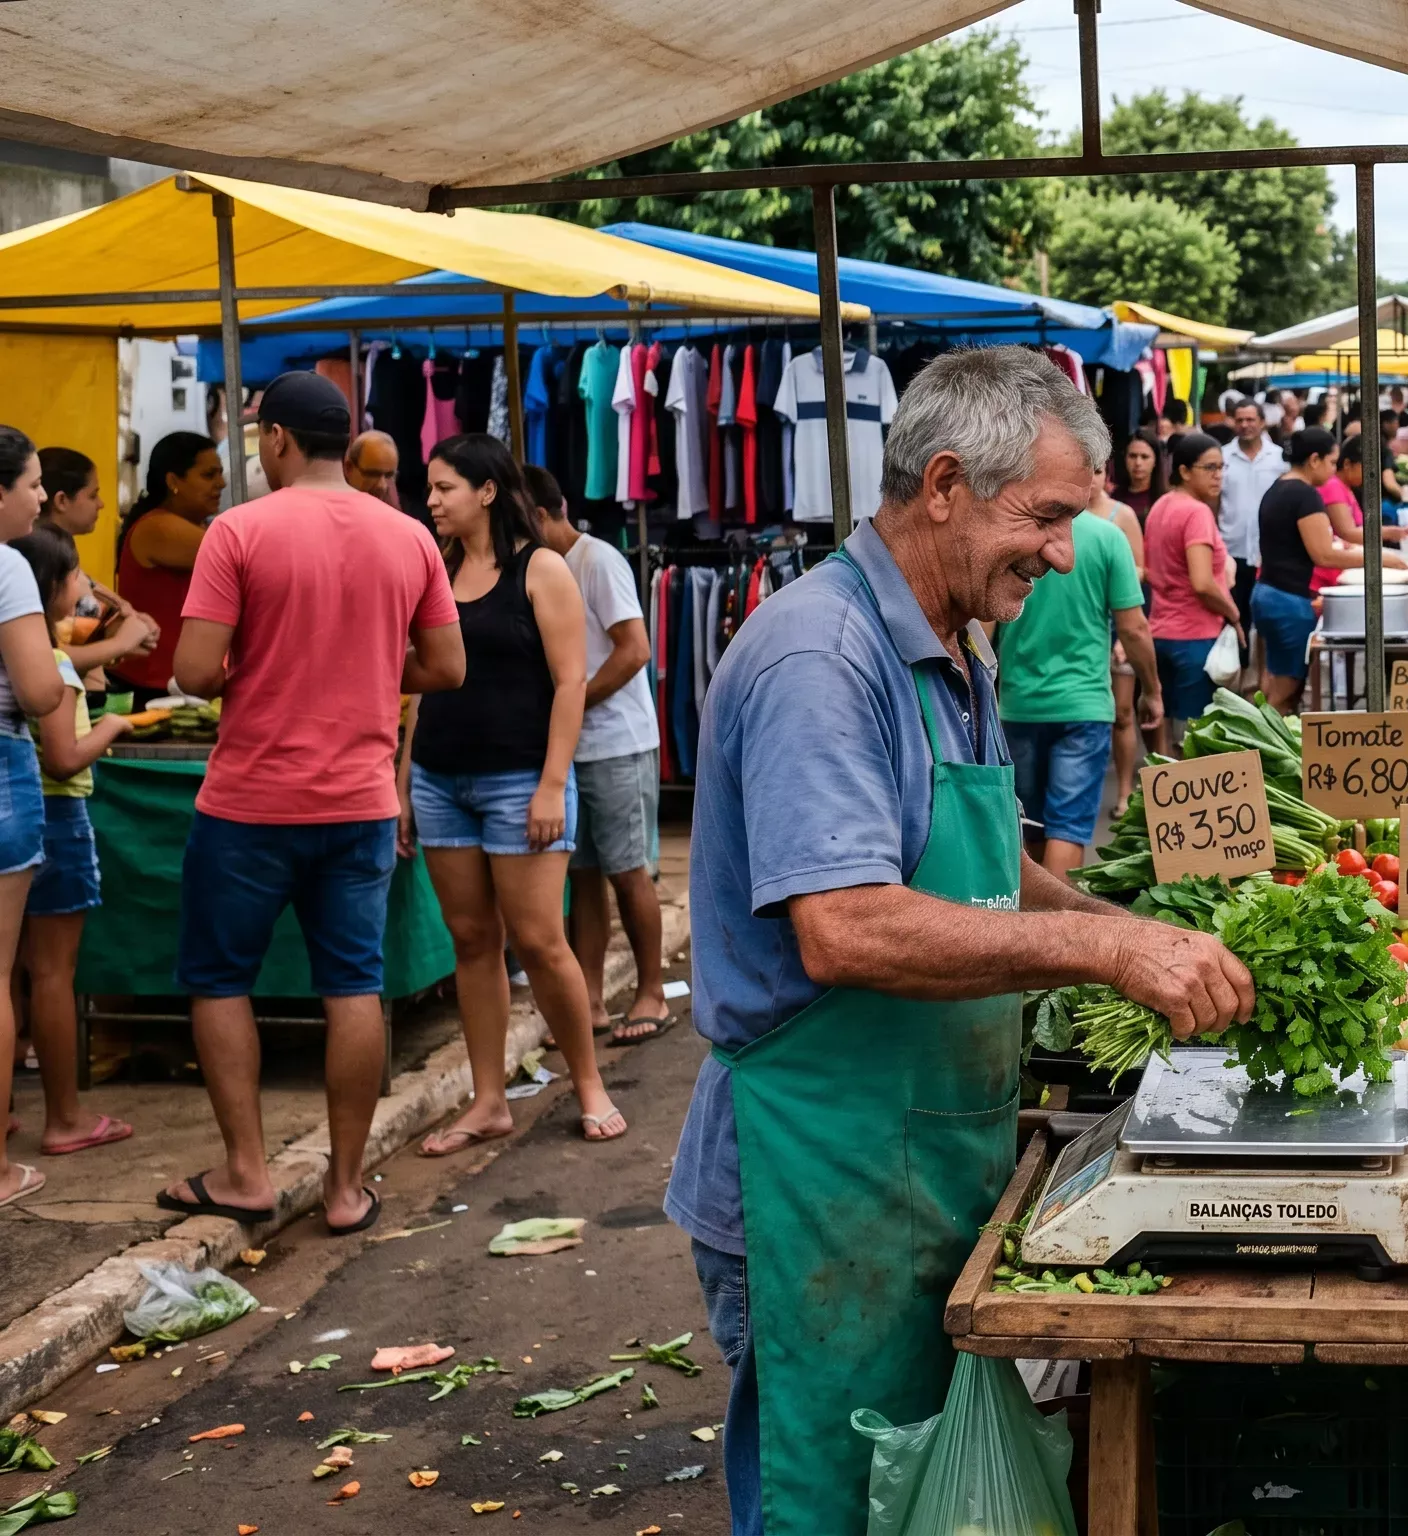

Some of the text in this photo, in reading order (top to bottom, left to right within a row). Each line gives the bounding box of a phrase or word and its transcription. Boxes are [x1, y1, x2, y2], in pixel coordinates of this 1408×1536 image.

[1151, 769, 1250, 809] Couve:
[1307, 763, 1338, 789] R$
[1155, 802, 1256, 854] R$ 3,50
[1223, 839, 1266, 860] maço
[1189, 1203, 1338, 1222] BALANÇAS TOLEDO
